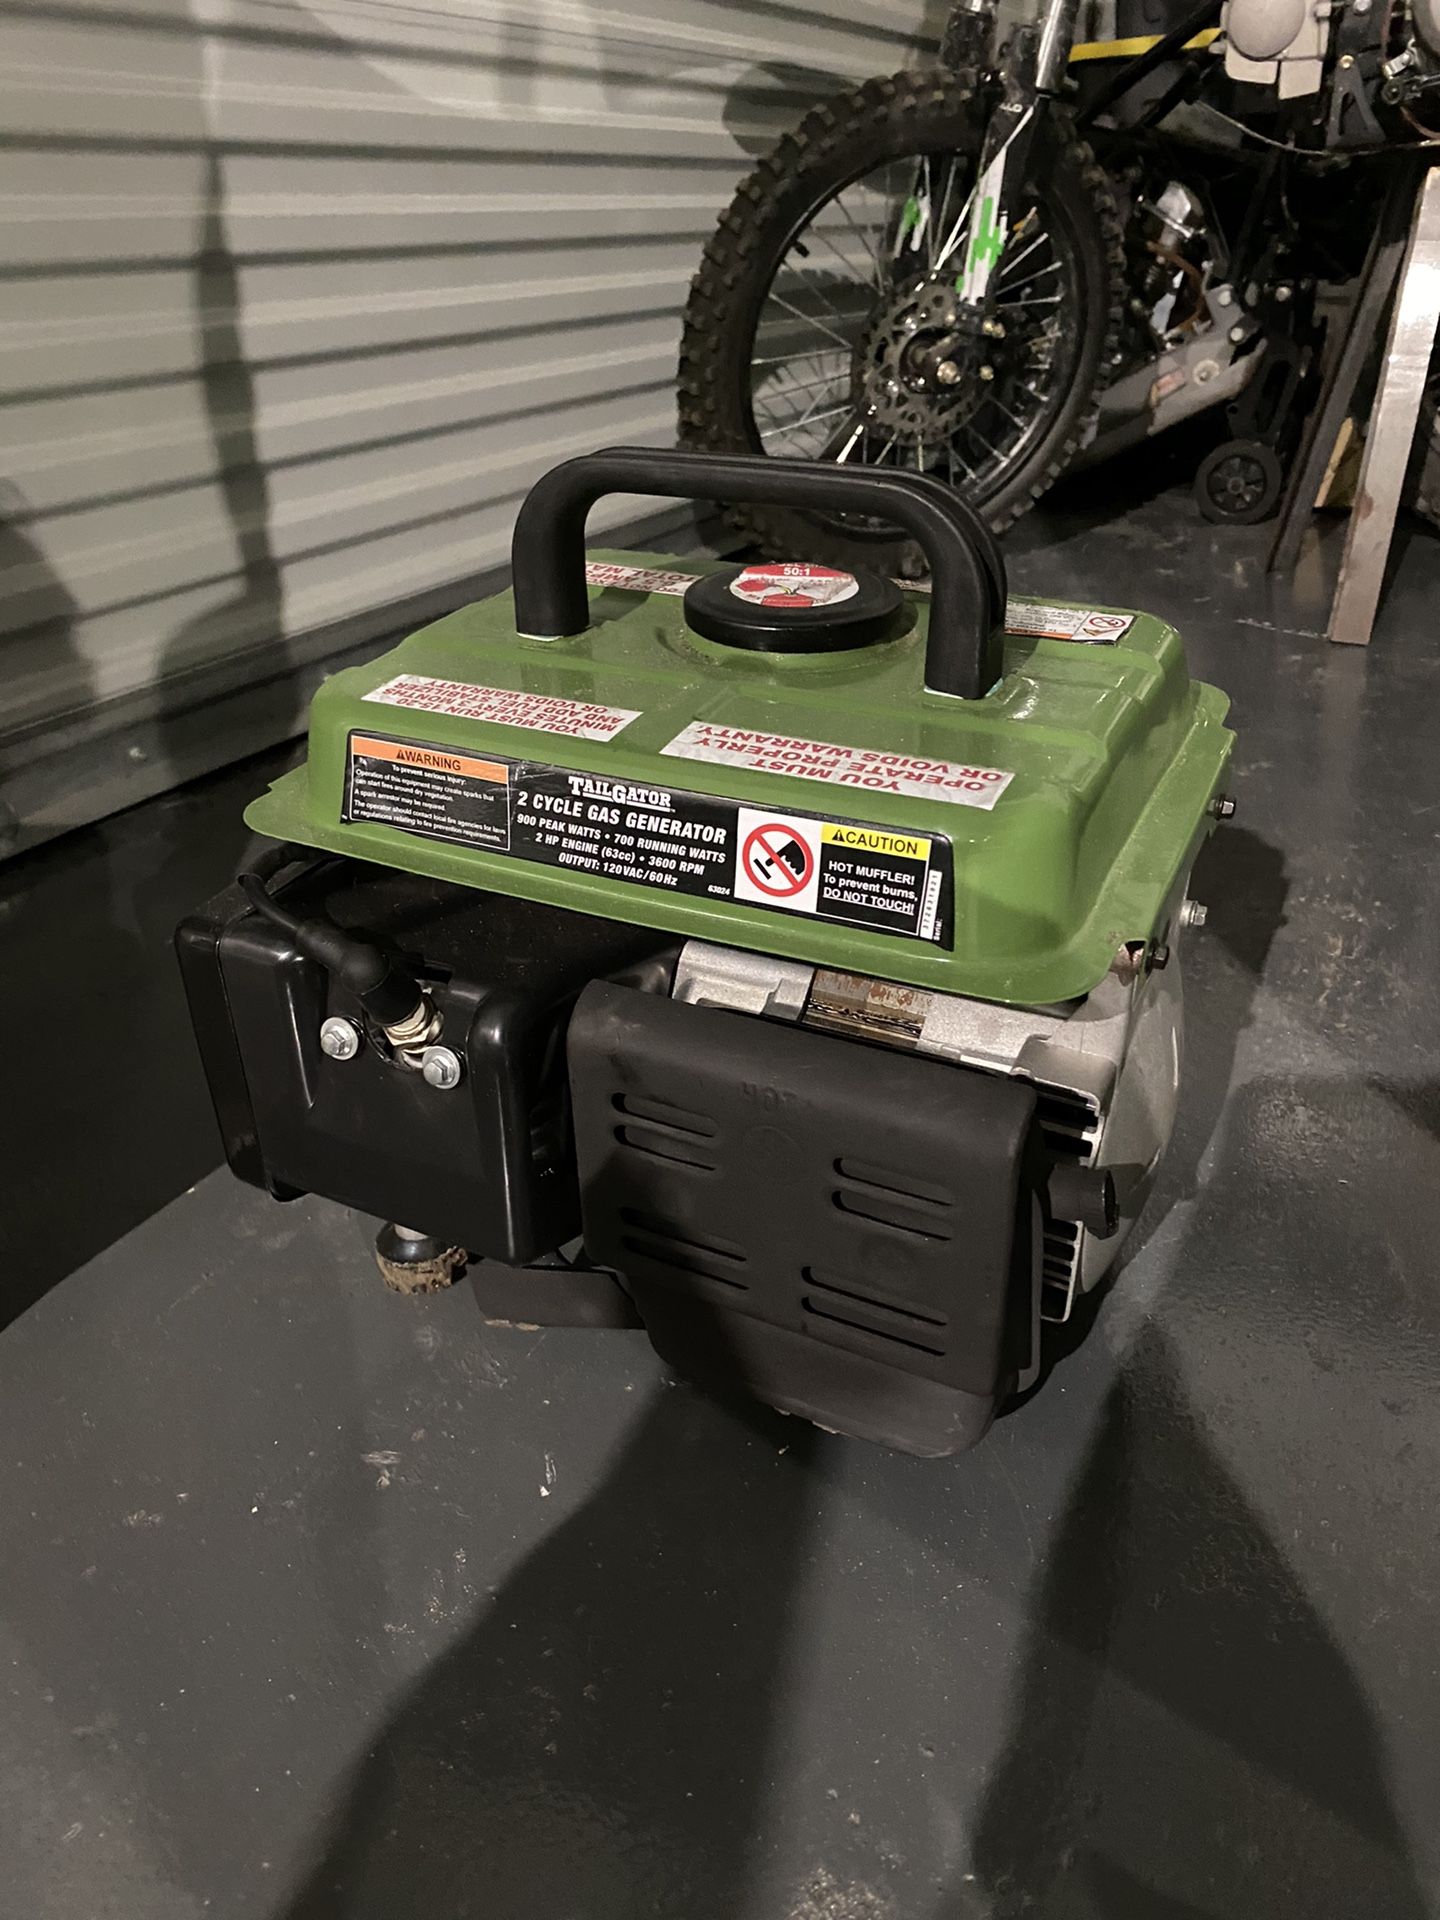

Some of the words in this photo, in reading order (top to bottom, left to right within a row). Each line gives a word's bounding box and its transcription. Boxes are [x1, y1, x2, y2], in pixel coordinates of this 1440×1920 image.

[586, 564, 625, 573] MA
[632, 570, 695, 582] TOTAL
[783, 567, 810, 576] 50:1
[382, 687, 457, 705] MONTHS
[393, 681, 489, 703] STABILIZER
[423, 679, 521, 700] WARRANTY
[397, 697, 441, 710] 15-20
[445, 705, 483, 718] RUN
[473, 703, 532, 720] EVERY
[493, 697, 539, 711] FUEL
[523, 694, 577, 710] VOIDS
[542, 704, 580, 717] ADD
[582, 704, 608, 714] OR
[486, 713, 536, 727] MUST
[535, 713, 617, 732] MINUTES
[539, 720, 579, 735] YOU
[580, 711, 624, 725] AND
[697, 725, 854, 758] WARRANTY
[405, 751, 461, 770] WARNING
[693, 737, 839, 768] PROPERLY
[749, 758, 833, 779] MUST
[862, 753, 948, 774] VOIDS
[401, 767, 423, 777] prevent
[425, 771, 446, 780] serious
[840, 773, 901, 792] YOU
[846, 762, 985, 792] OPERATE
[952, 768, 1002, 782] OR
[356, 769, 383, 779] Operation
[391, 774, 400, 782] this
[402, 777, 430, 789] equipment
[431, 782, 443, 792] may
[444, 785, 462, 795] create
[463, 790, 482, 800] sparks
[483, 793, 494, 801] that
[367, 779, 380, 787] start
[394, 784, 413, 794] around
[415, 788, 423, 796] dry
[360, 790, 377, 799] spark
[401, 797, 413, 806] may
[354, 800, 364, 808] The
[366, 803, 391, 813] operator
[393, 806, 411, 815] should
[413, 810, 432, 820] contact
[458, 819, 482, 831] agencies
[360, 810, 393, 821] regulations
[394, 815, 415, 826] relating
[433, 823, 462, 834] prevention
[518, 791, 529, 806] 2
[533, 794, 581, 817] CYCLE
[588, 805, 620, 825] GAS
[626, 811, 727, 844] GENERATOR
[517, 814, 536, 826] 900
[539, 819, 565, 832] PEAK
[568, 824, 601, 840] WATTS
[614, 834, 634, 846] 700
[637, 838, 686, 856] RUNNING
[689, 847, 726, 863] WATTS
[846, 831, 918, 855] CAUTION
[535, 832, 543, 842] 2
[545, 834, 560, 846] HP
[562, 838, 599, 855] ENGINE
[601, 846, 635, 864] (63cc)
[648, 856, 677, 870] 3600
[679, 861, 705, 875] RPM
[559, 852, 600, 870] OUTPUT:
[829, 861, 854, 874] HOT
[856, 865, 915, 885] MUFFLER!
[823, 873, 836, 884] To
[838, 877, 880, 894] prevent
[883, 885, 918, 902] burns,
[823, 888, 841, 901] DO
[843, 891, 869, 905] NOT
[871, 896, 915, 916] TOUCH!
